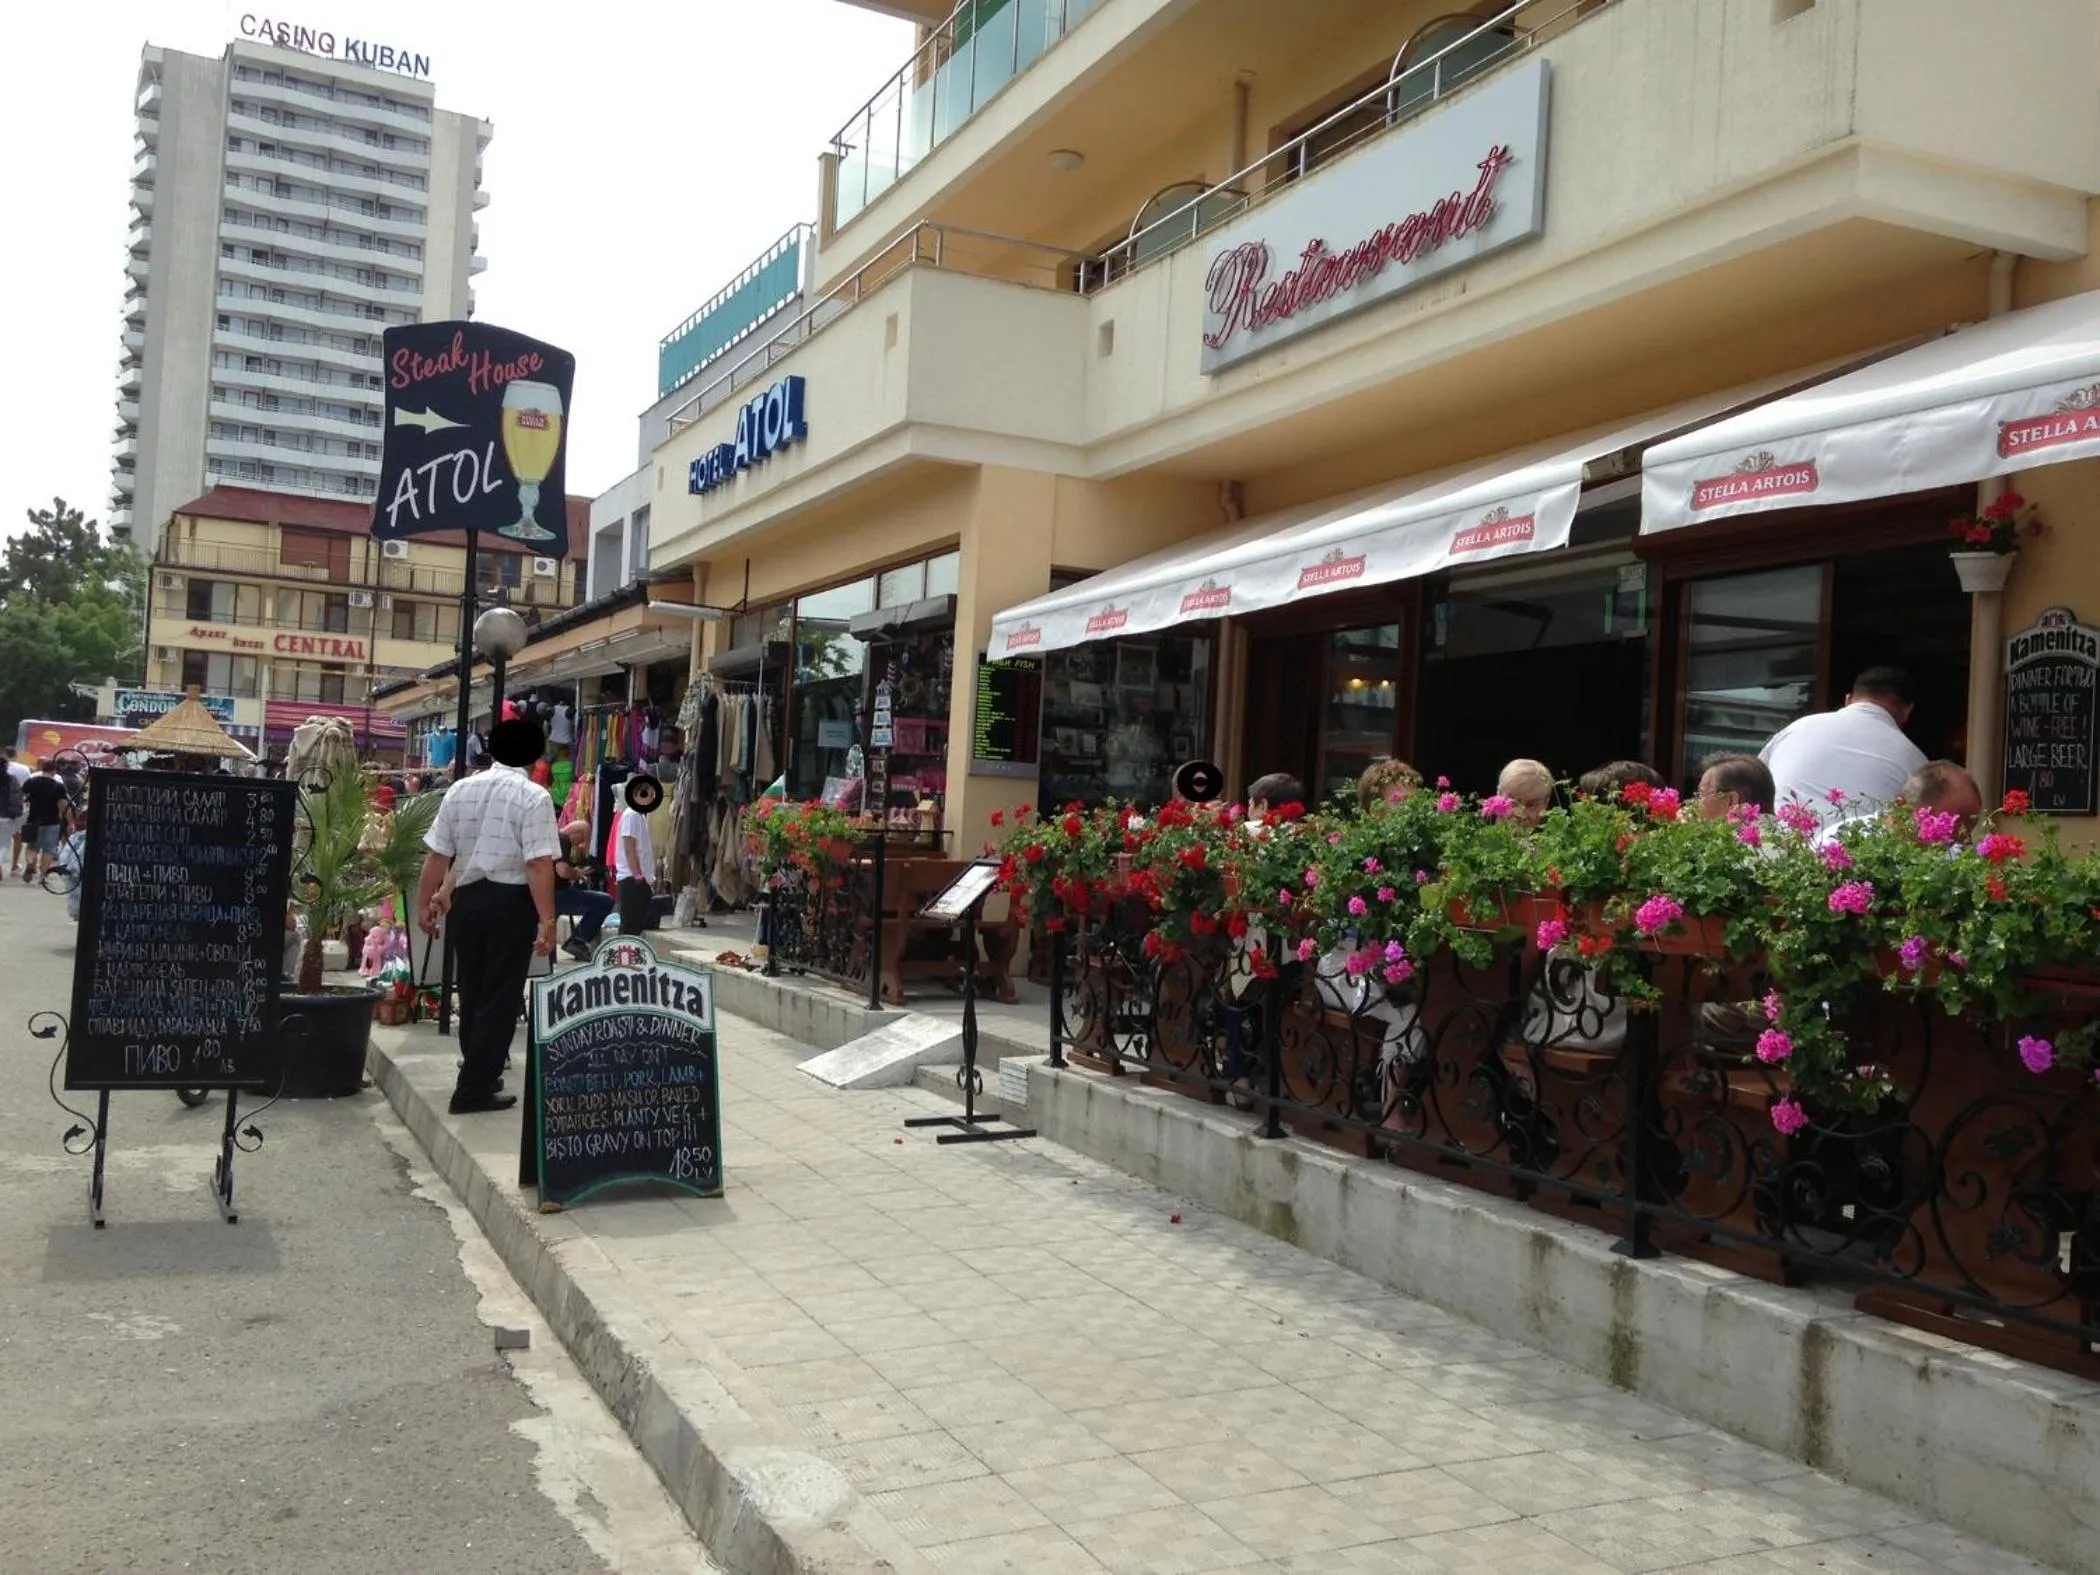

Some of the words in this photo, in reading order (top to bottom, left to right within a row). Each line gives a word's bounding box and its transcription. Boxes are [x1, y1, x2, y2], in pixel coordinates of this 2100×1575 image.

[345, 37, 430, 77] KUBAN
[391, 330, 469, 389] Steak
[468, 349, 545, 395] House
[689, 443, 736, 494] HOTEL
[732, 375, 808, 470] ATOL
[2009, 419, 2077, 446] STELLA
[2083, 415, 2100, 431] A
[386, 440, 503, 527] ATOL
[1699, 481, 1748, 502] STELLA
[1753, 470, 1810, 491] ARTOIS
[1455, 529, 1491, 548] STELLA
[1493, 520, 1531, 540] ARTOIS
[274, 633, 366, 659] CENTRAL
[2010, 626, 2097, 665] Kamenitza
[2011, 667, 2051, 691] DINNER
[2051, 743, 2089, 770] BEER
[153, 865, 189, 884] ПИВО
[547, 967, 703, 1028] Kamenitza
[547, 1027, 596, 1061] SUNDAY
[636, 1017, 649, 1035] &
[651, 1017, 700, 1048] DINNER
[126, 1044, 181, 1076] ПИВО
[614, 1106, 660, 1127] PLANTY
[545, 1135, 582, 1160] BISTO
[586, 1131, 629, 1157] GRAVY
[653, 1128, 681, 1147] TOP
